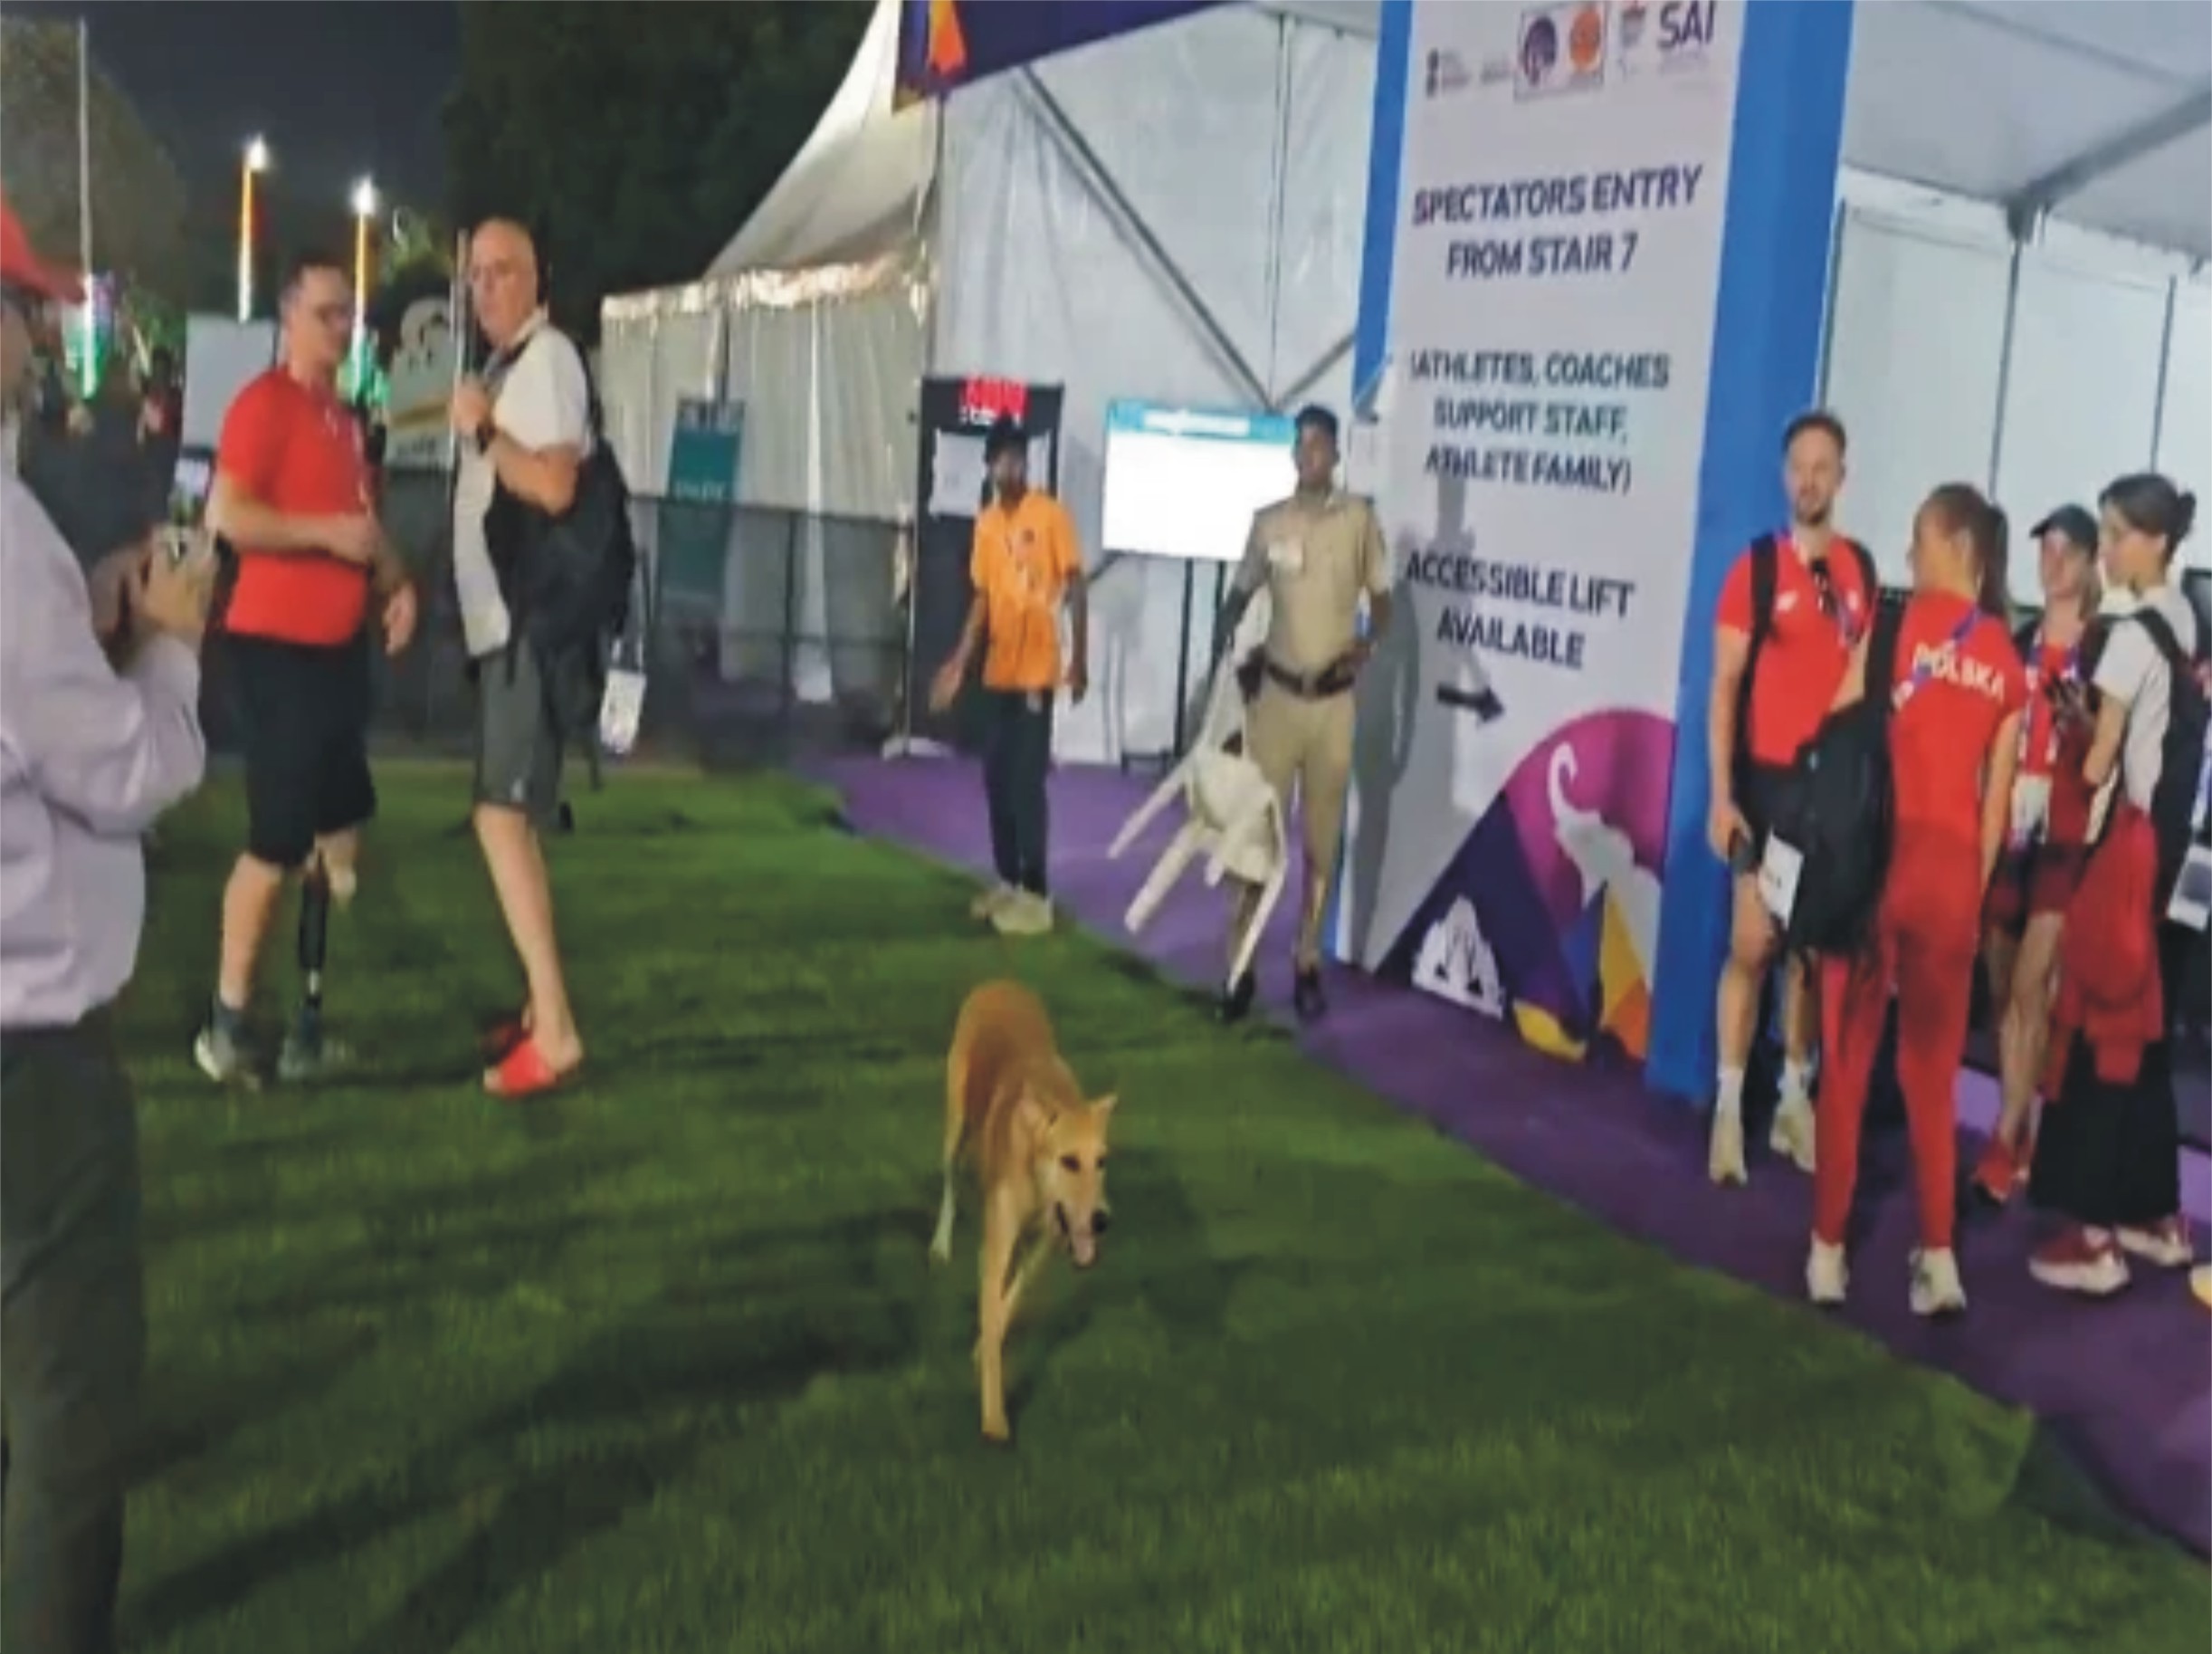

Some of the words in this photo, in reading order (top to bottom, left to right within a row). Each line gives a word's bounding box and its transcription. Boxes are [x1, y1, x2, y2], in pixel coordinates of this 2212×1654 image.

[1658, 0, 1715, 48] SAI
[1413, 174, 1587, 225] SPECTATORS
[1591, 164, 1702, 212] ENTRY
[1447, 238, 1522, 277] FROM
[1528, 233, 1613, 275] STAIR
[1621, 232, 1638, 272] 7
[1545, 351, 1670, 387] COACHES
[1434, 397, 1537, 434] SUPPORT
[1543, 405, 1626, 445] STAFF,
[1425, 444, 1530, 483] ATHLETE
[1531, 451, 1631, 495] FAMILY)
[1406, 550, 1566, 606] ACCESSIBLE
[1569, 571, 1636, 617] LIFT
[1437, 606, 1586, 669] AVAILABLE
[1912, 641, 2006, 705] POLSKA
